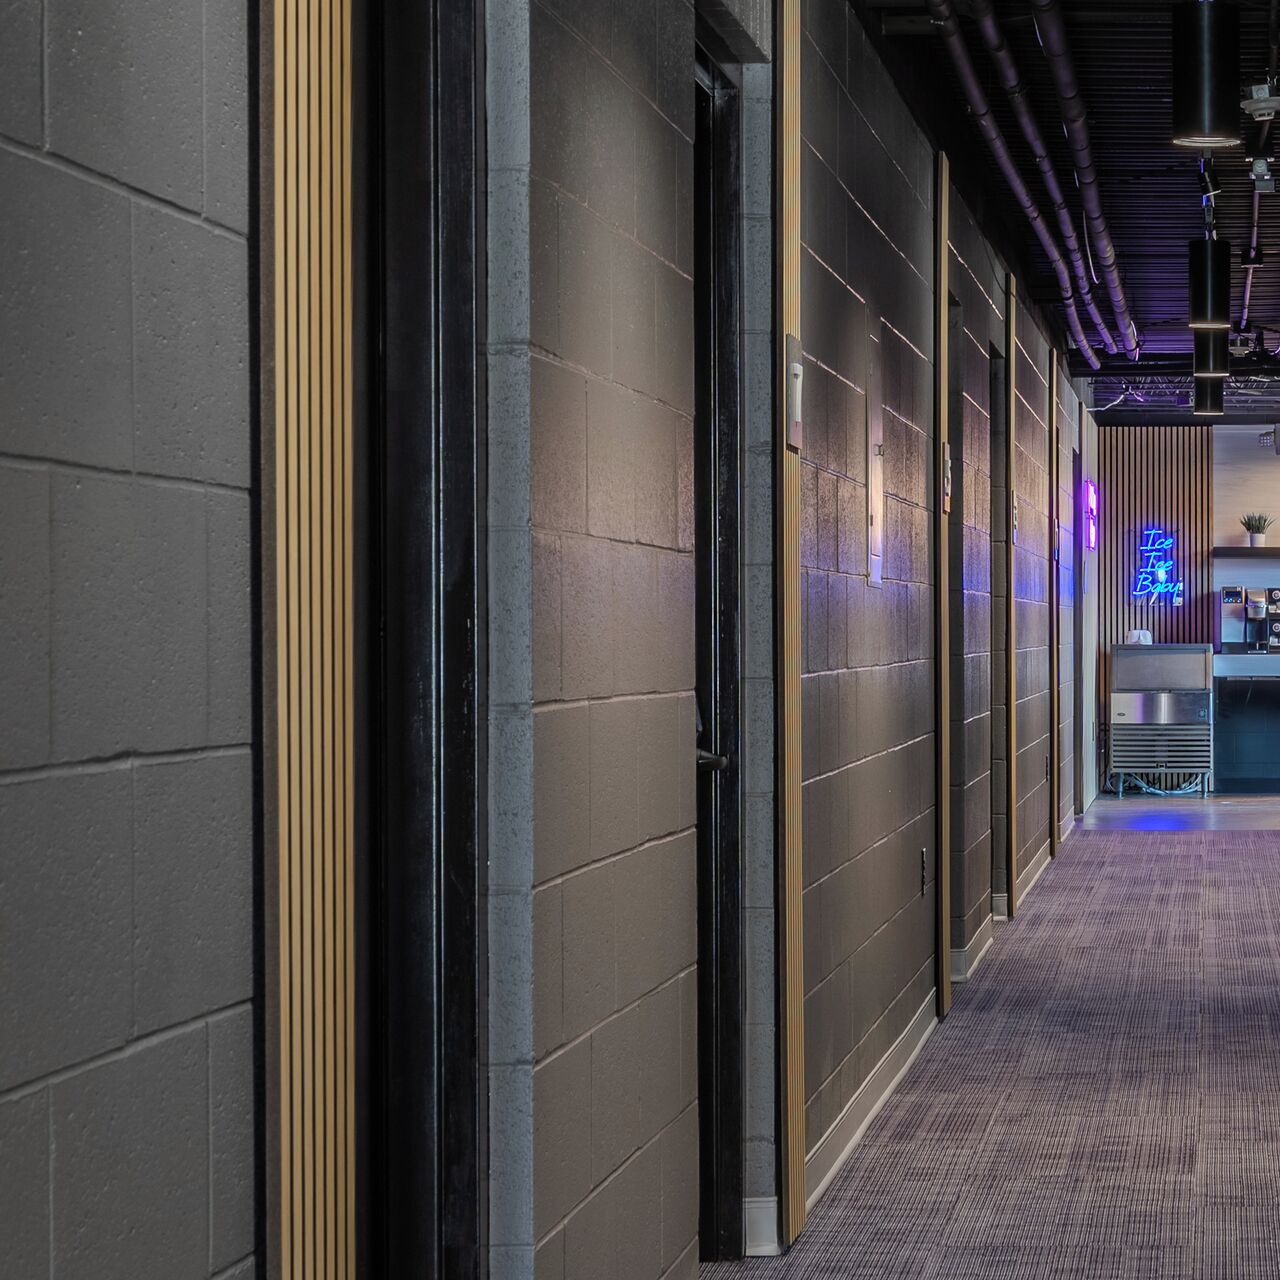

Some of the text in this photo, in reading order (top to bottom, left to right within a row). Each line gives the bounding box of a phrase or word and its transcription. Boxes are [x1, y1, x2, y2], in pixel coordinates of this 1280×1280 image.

[1140, 529, 1173, 550] Ice
[1140, 551, 1173, 572] Ice
[1133, 573, 1180, 603] Baby
